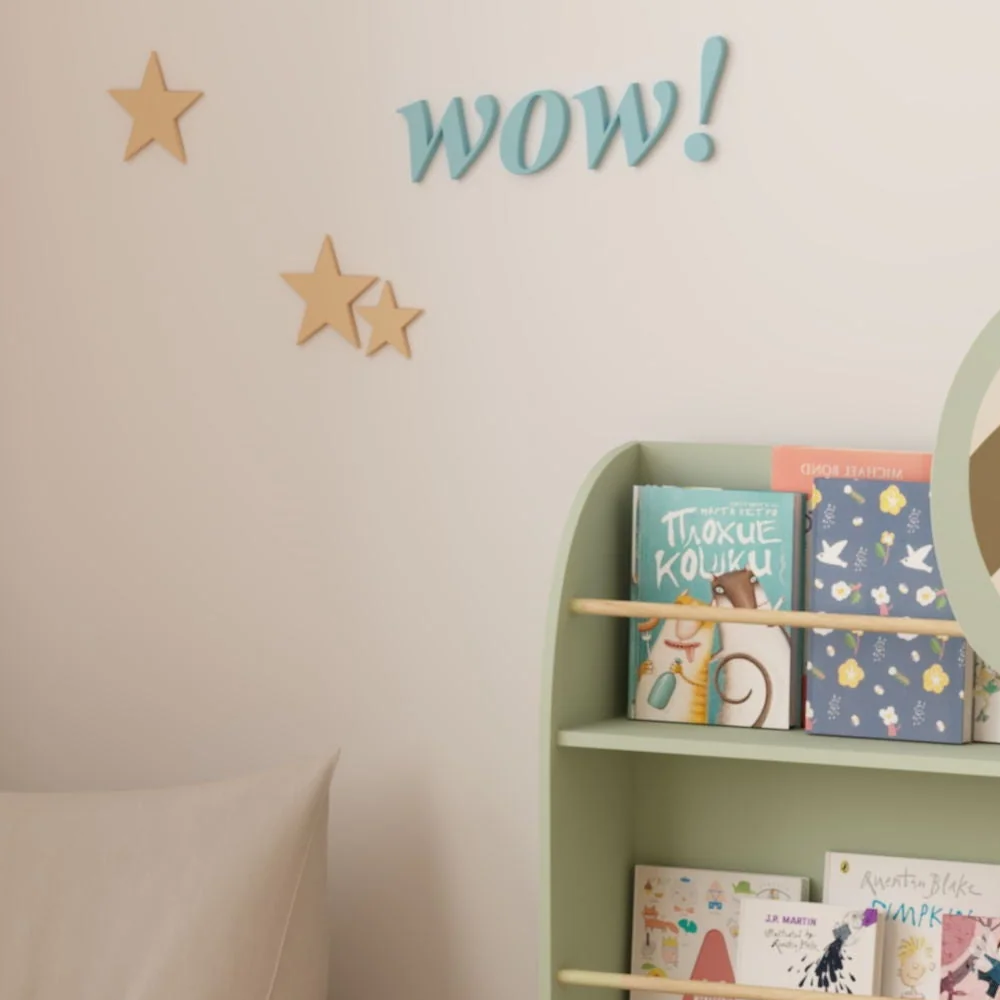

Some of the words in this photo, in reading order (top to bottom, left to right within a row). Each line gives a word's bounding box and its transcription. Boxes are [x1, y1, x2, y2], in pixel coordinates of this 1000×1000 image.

[923, 873, 984, 899] Blake
[765, 914, 780, 923] J.P.
[782, 916, 817, 926] MARTIN
